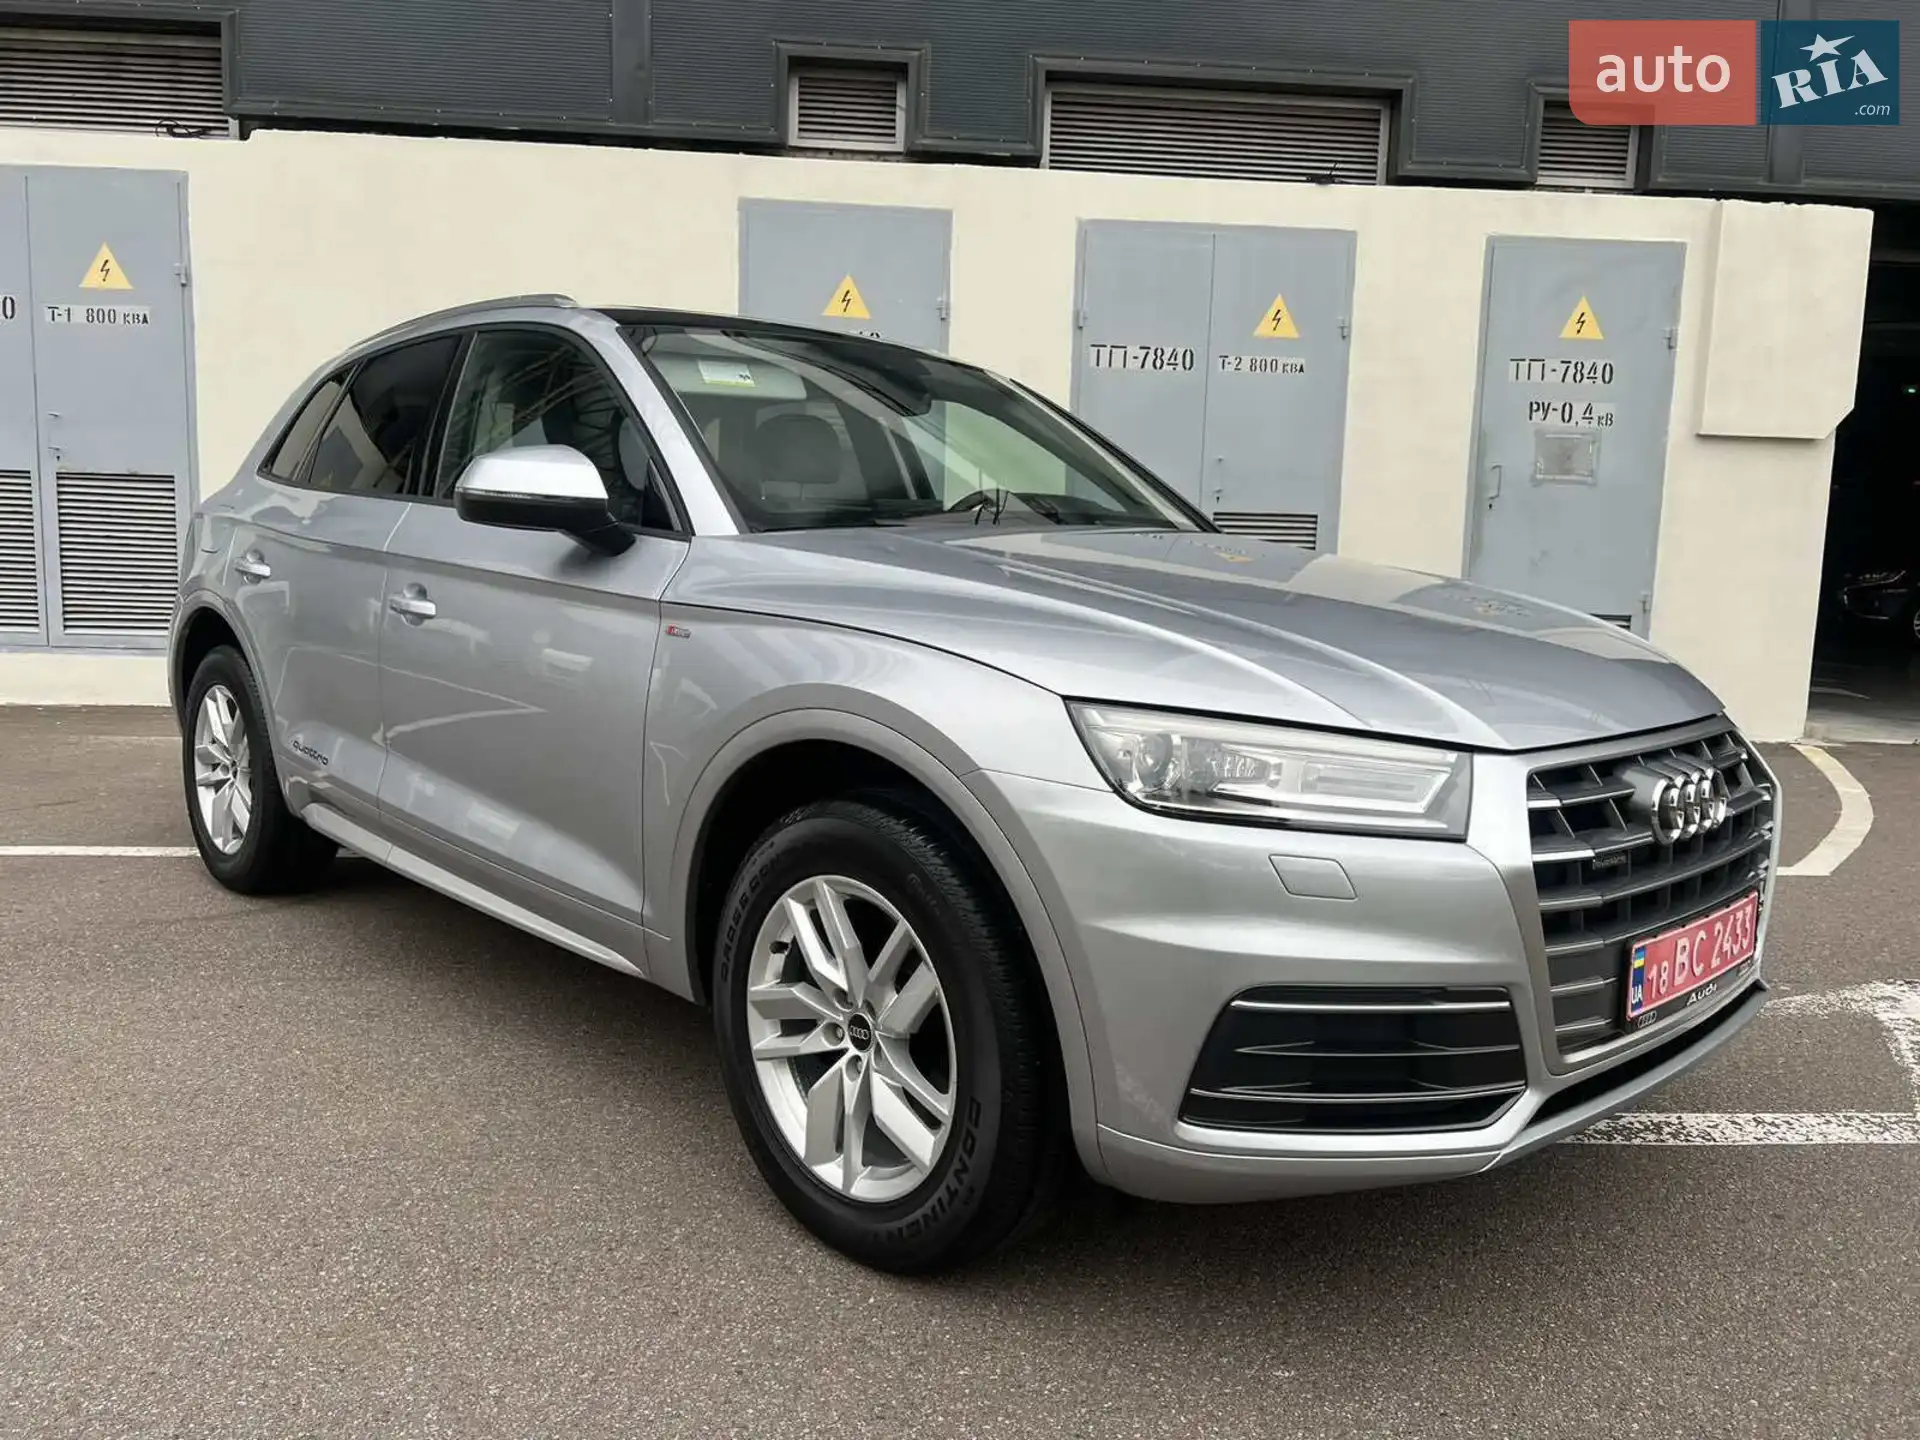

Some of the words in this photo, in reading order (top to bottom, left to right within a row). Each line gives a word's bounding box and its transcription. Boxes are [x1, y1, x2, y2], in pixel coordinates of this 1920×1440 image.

[47, 306, 71, 323] Т-1
[86, 308, 117, 325] 800
[1090, 343, 1195, 371] ТП-7840
[1219, 355, 1242, 372] Т-2
[1249, 358, 1278, 374] 800
[1509, 358, 1614, 385] ТП-7840
[1631, 984, 1643, 1005] UA
[1648, 961, 1669, 1000] 18
[1673, 929, 1708, 988] BC
[1710, 903, 1753, 969] 2433
